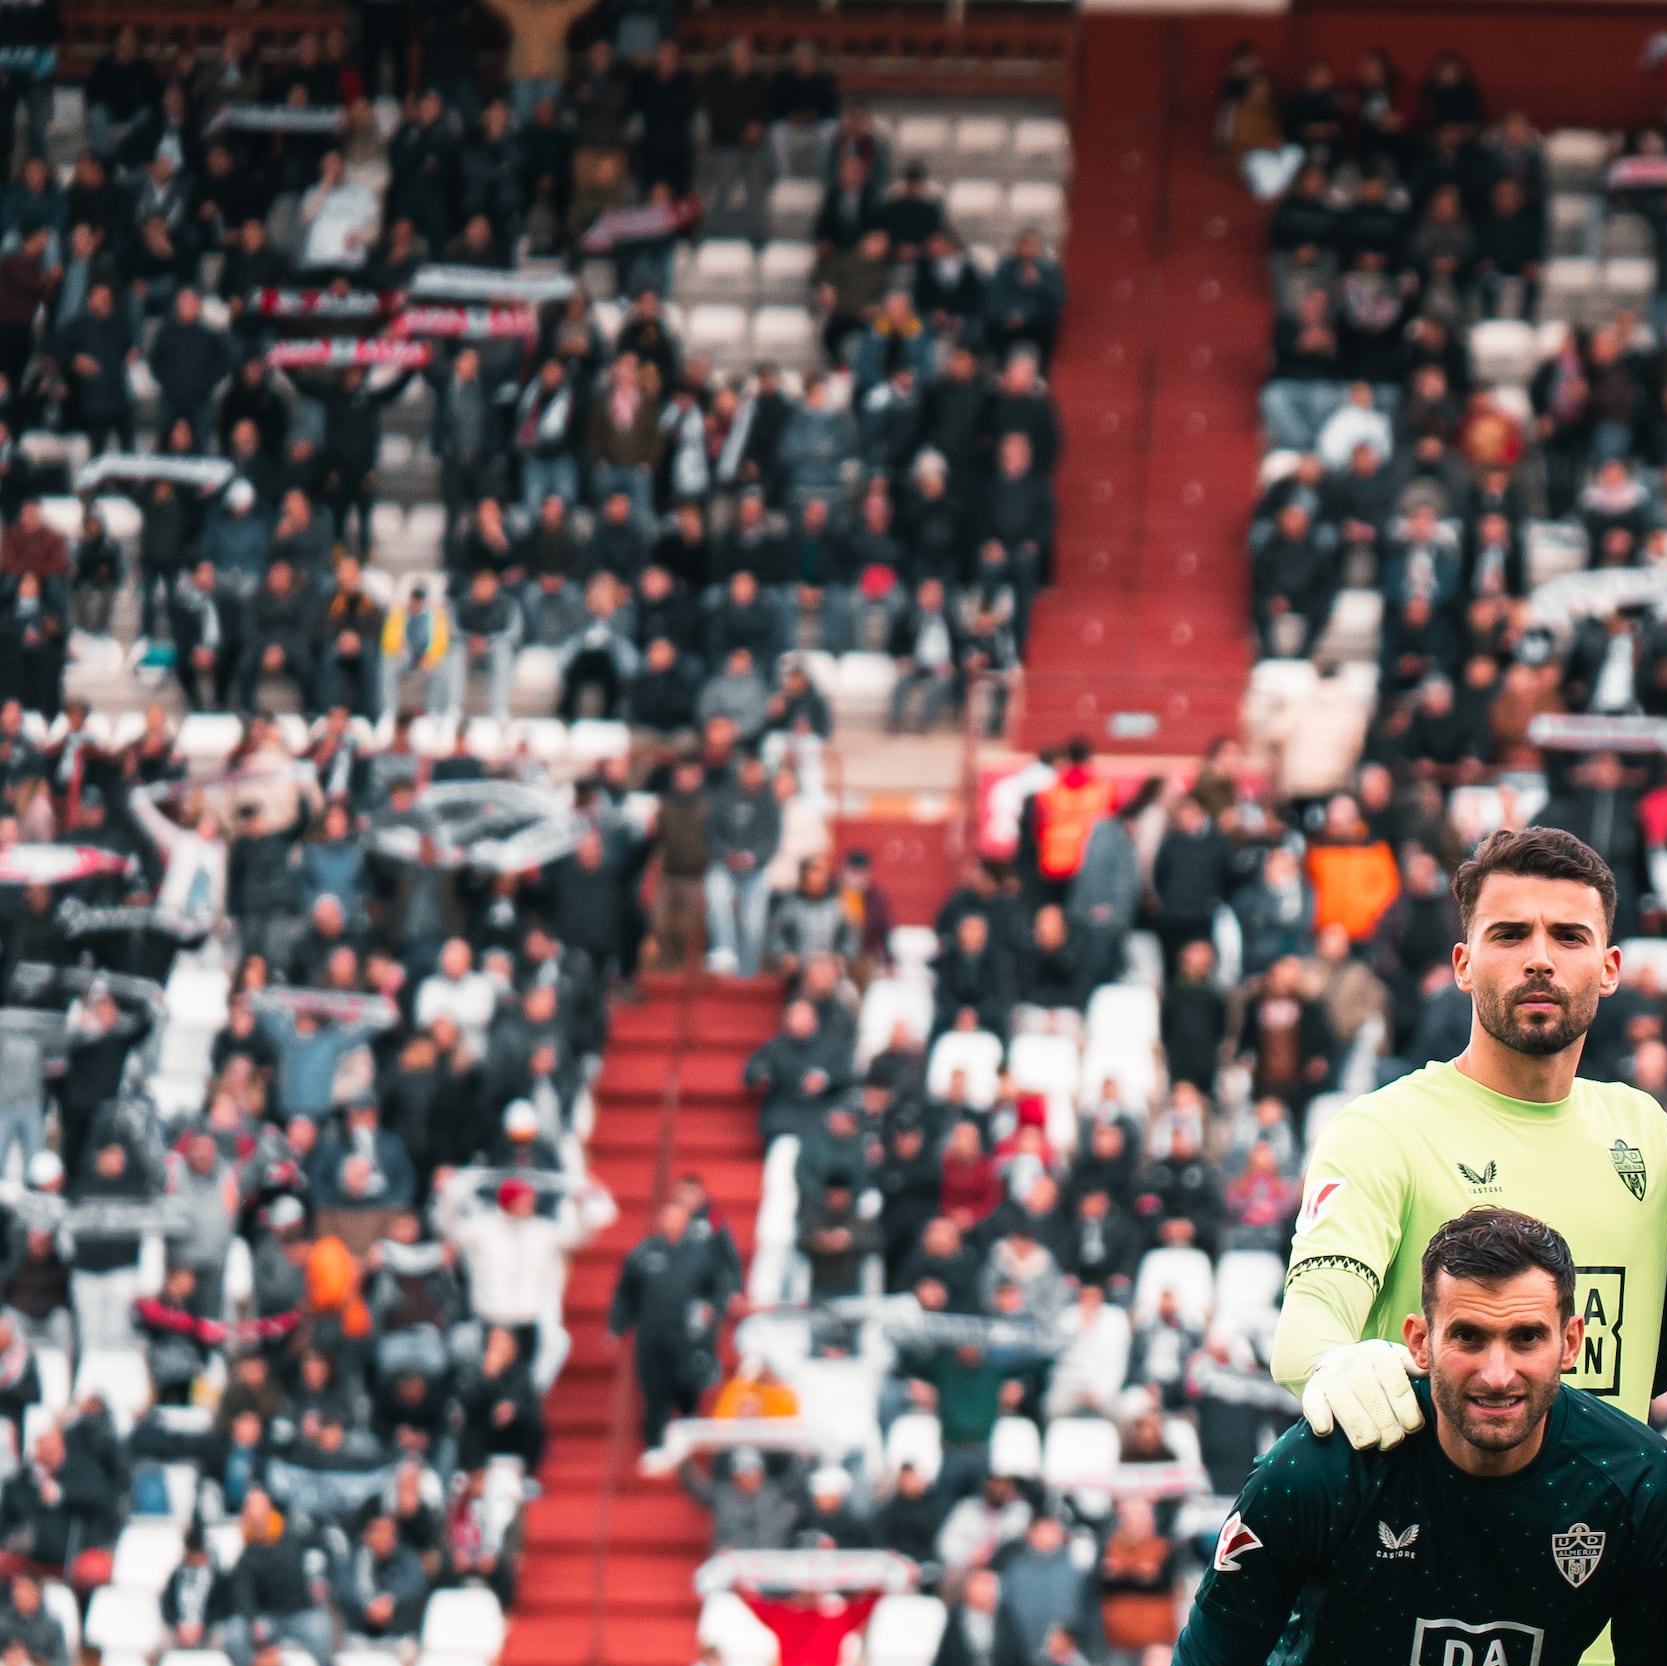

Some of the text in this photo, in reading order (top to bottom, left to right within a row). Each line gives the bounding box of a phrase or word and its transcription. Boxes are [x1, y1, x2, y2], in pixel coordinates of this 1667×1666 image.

[1573, 1289, 1606, 1326] A
[1376, 1550, 1415, 1559] CASTORE
[1558, 1549, 1597, 1557] ALMERIA
